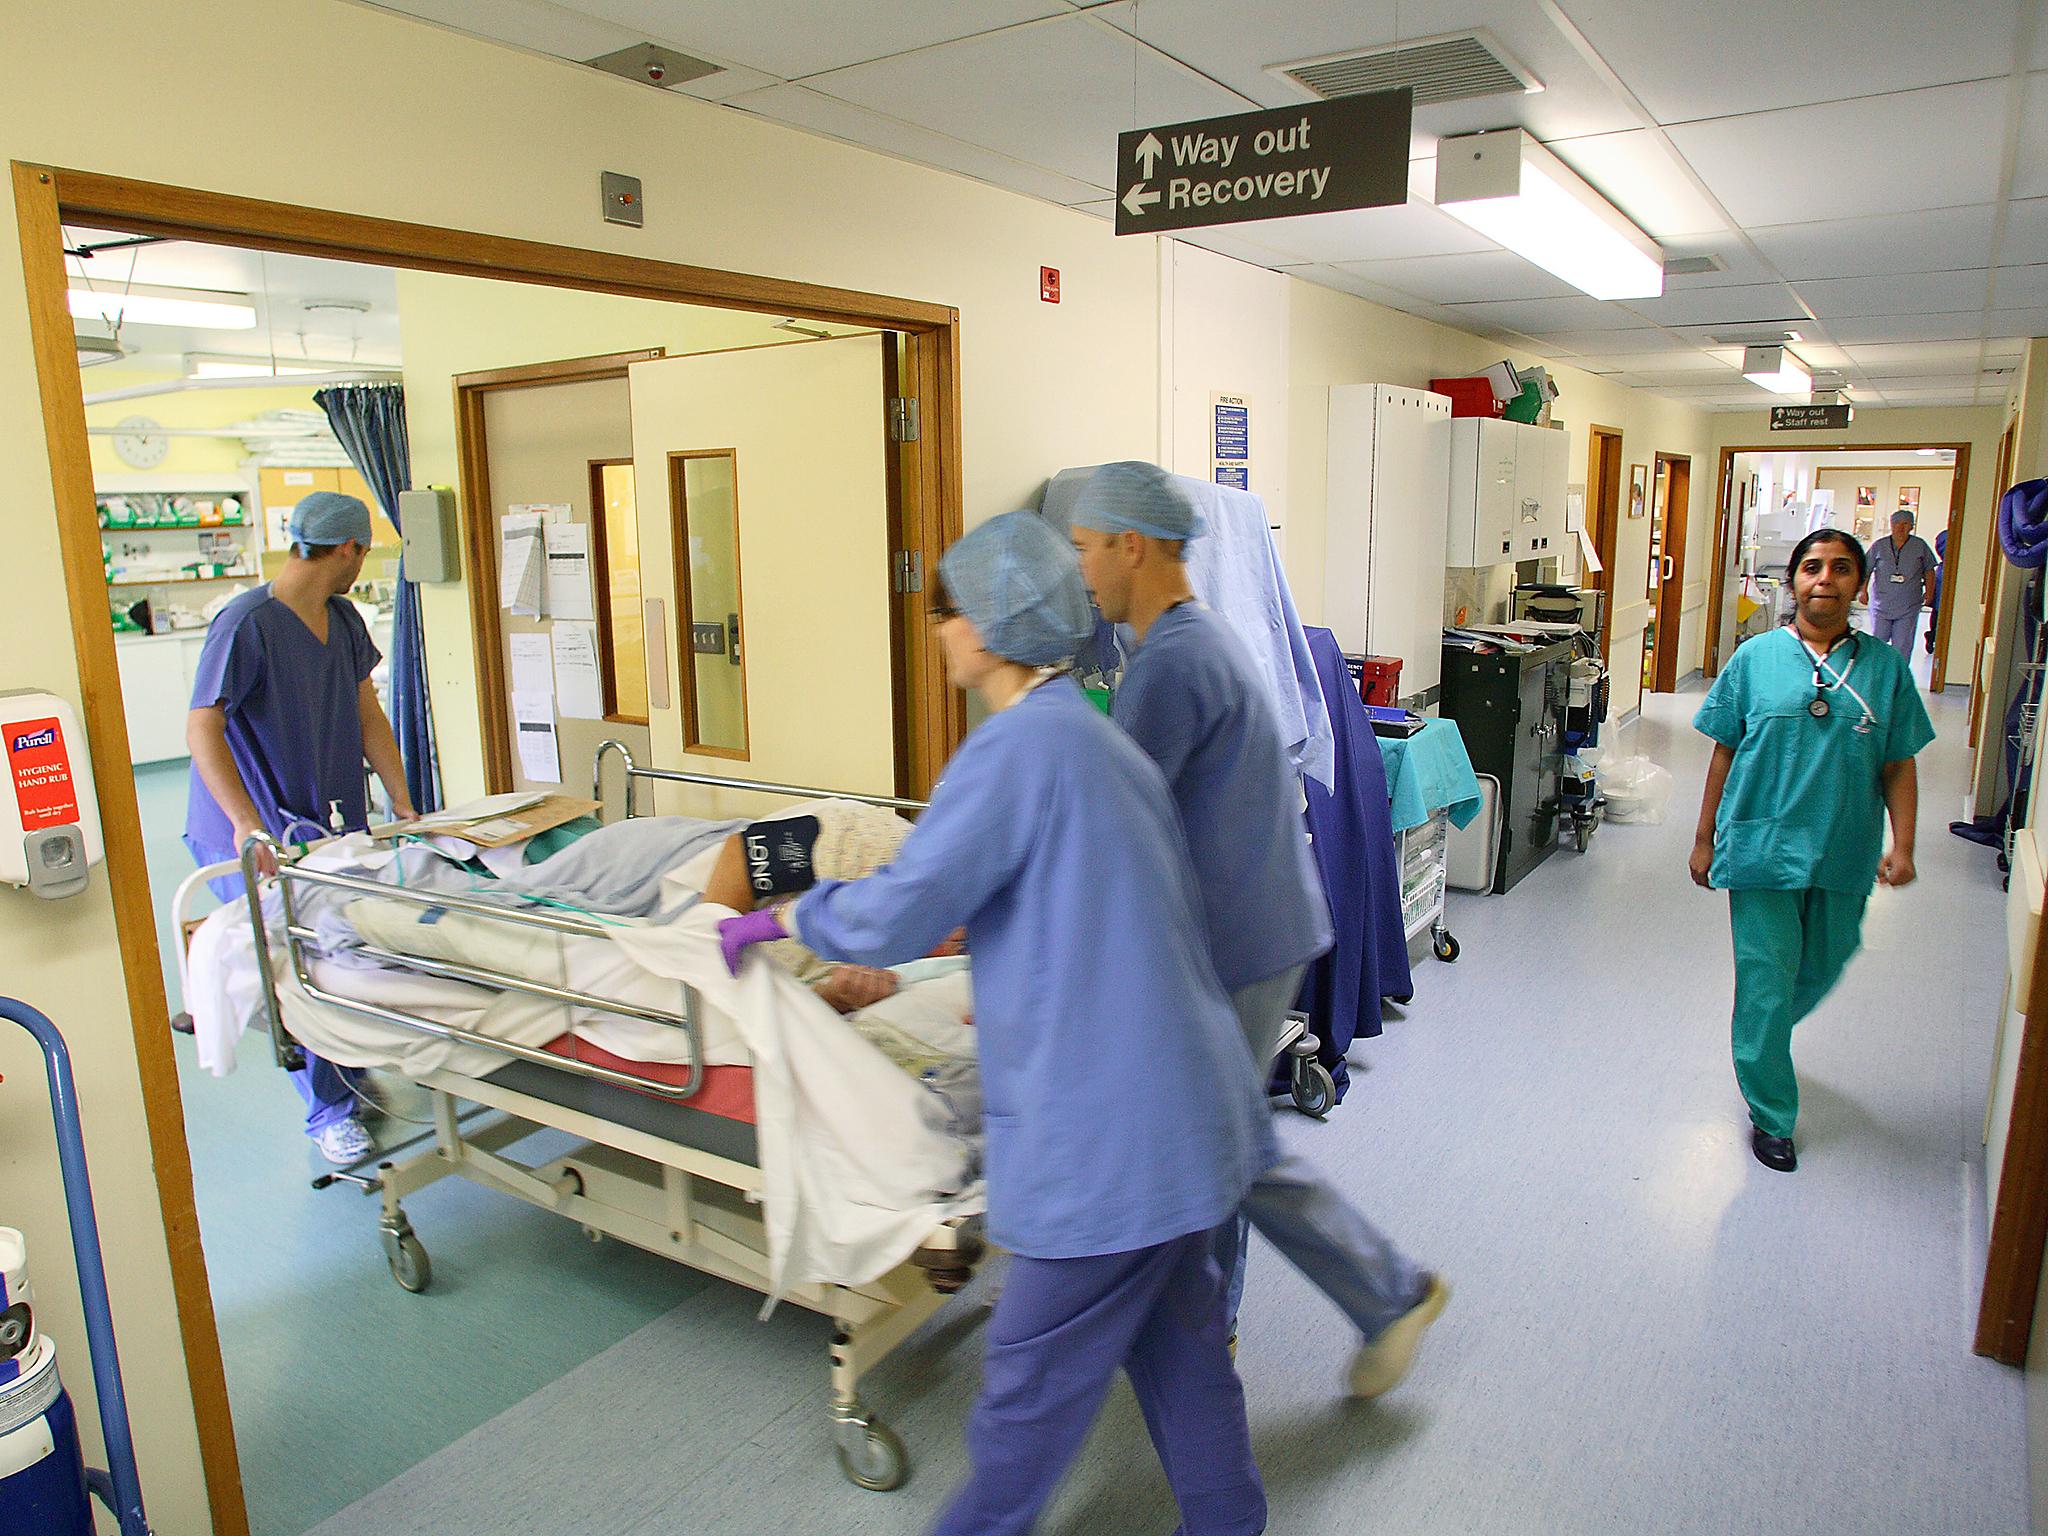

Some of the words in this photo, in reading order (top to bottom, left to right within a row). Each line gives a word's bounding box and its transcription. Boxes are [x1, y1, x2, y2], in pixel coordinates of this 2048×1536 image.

[1170, 132, 1239, 167] Way
[1253, 117, 1311, 156] out
[1168, 166, 1332, 210] Recovery
[1786, 408, 1806, 418] Way
[1808, 408, 1825, 416] out
[1785, 418, 1808, 427] Staff
[1810, 418, 1828, 426] rest
[18, 762, 63, 777] HYGIENIC
[19, 776, 47, 789] HAND
[48, 773, 68, 784] RUB
